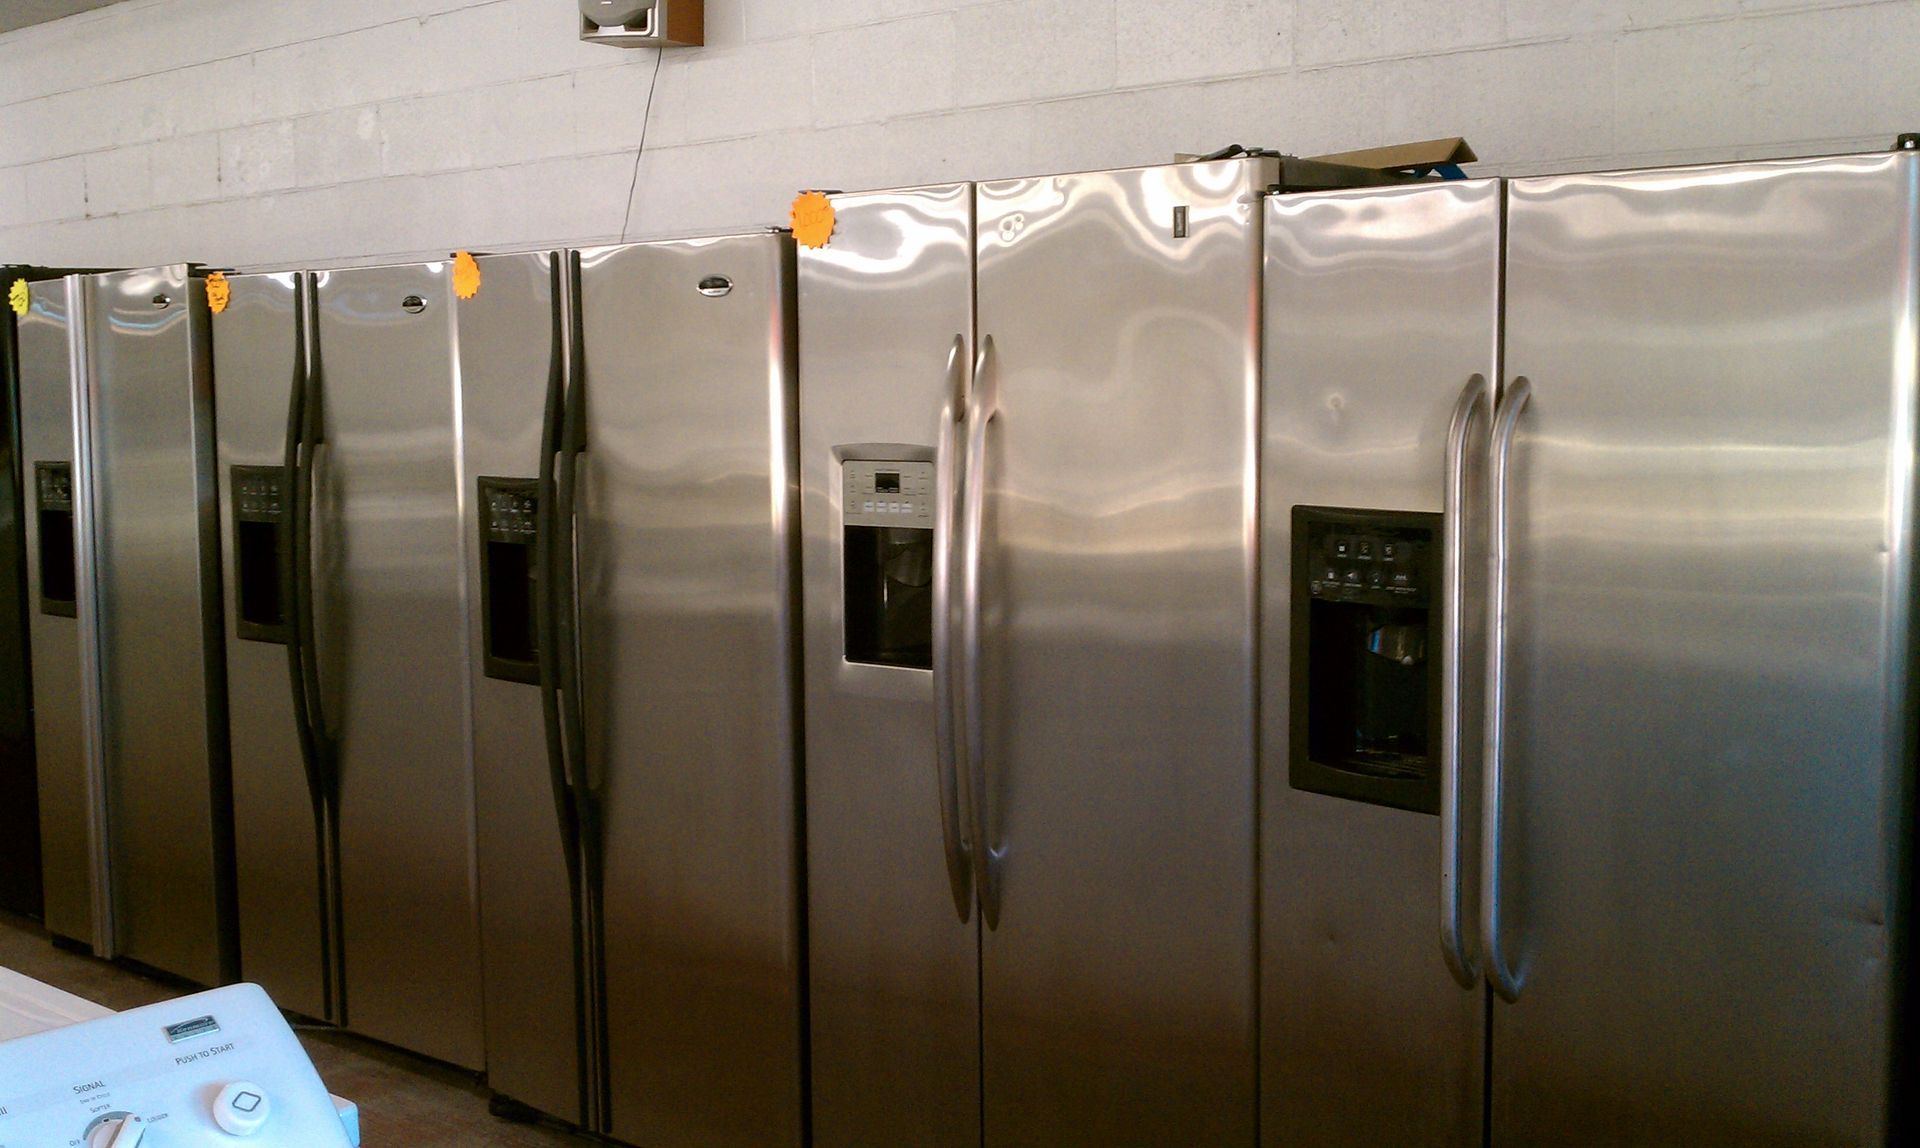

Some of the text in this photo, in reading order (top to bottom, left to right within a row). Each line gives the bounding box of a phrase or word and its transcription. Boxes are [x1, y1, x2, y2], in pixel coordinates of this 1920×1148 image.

[175, 1042, 234, 1065] PUSH TO START
[73, 1080, 106, 1094] SIGNAL
